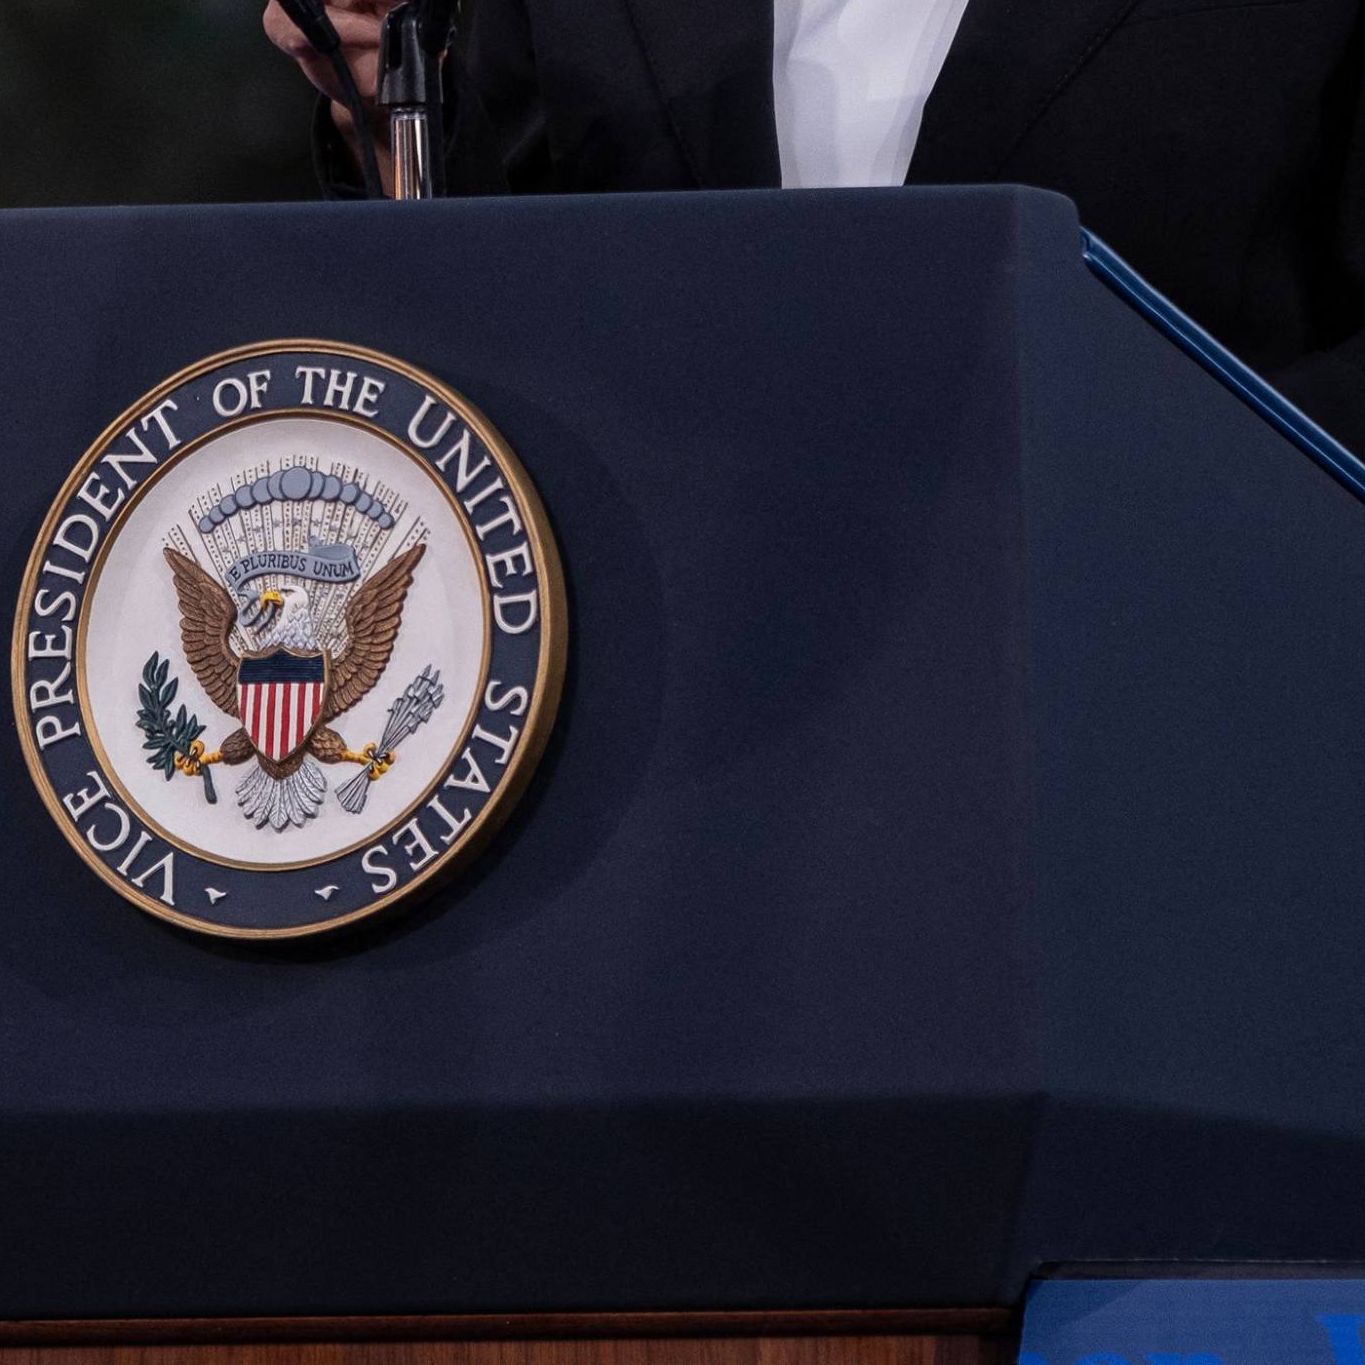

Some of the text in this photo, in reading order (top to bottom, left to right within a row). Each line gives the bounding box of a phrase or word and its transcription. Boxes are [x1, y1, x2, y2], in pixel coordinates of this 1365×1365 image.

[27, 365, 538, 906] VICE PRESIDENT OF THE UNITED STATES
[230, 554, 354, 581] E PLURIBUS UNUM
